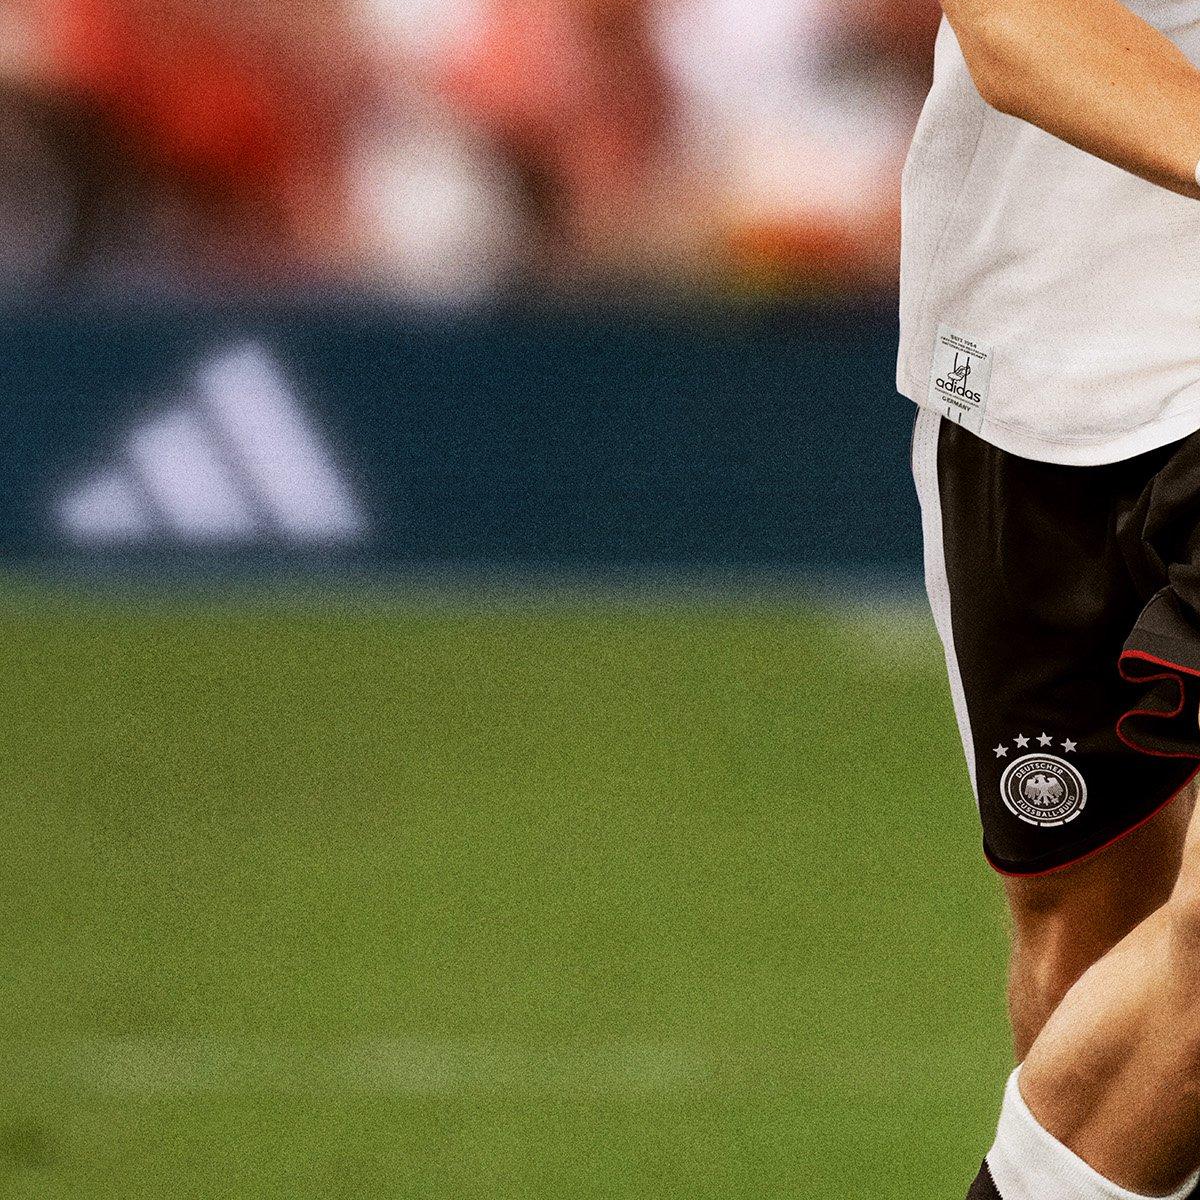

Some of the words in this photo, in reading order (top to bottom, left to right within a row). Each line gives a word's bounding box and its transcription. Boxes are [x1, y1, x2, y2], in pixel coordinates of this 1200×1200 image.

[935, 378, 981, 402] adidas
[941, 396, 971, 412] GERMANY
[1016, 763, 1064, 779] DEUTSCHER
[1017, 795, 1075, 818] FUSSBALL-BUND
